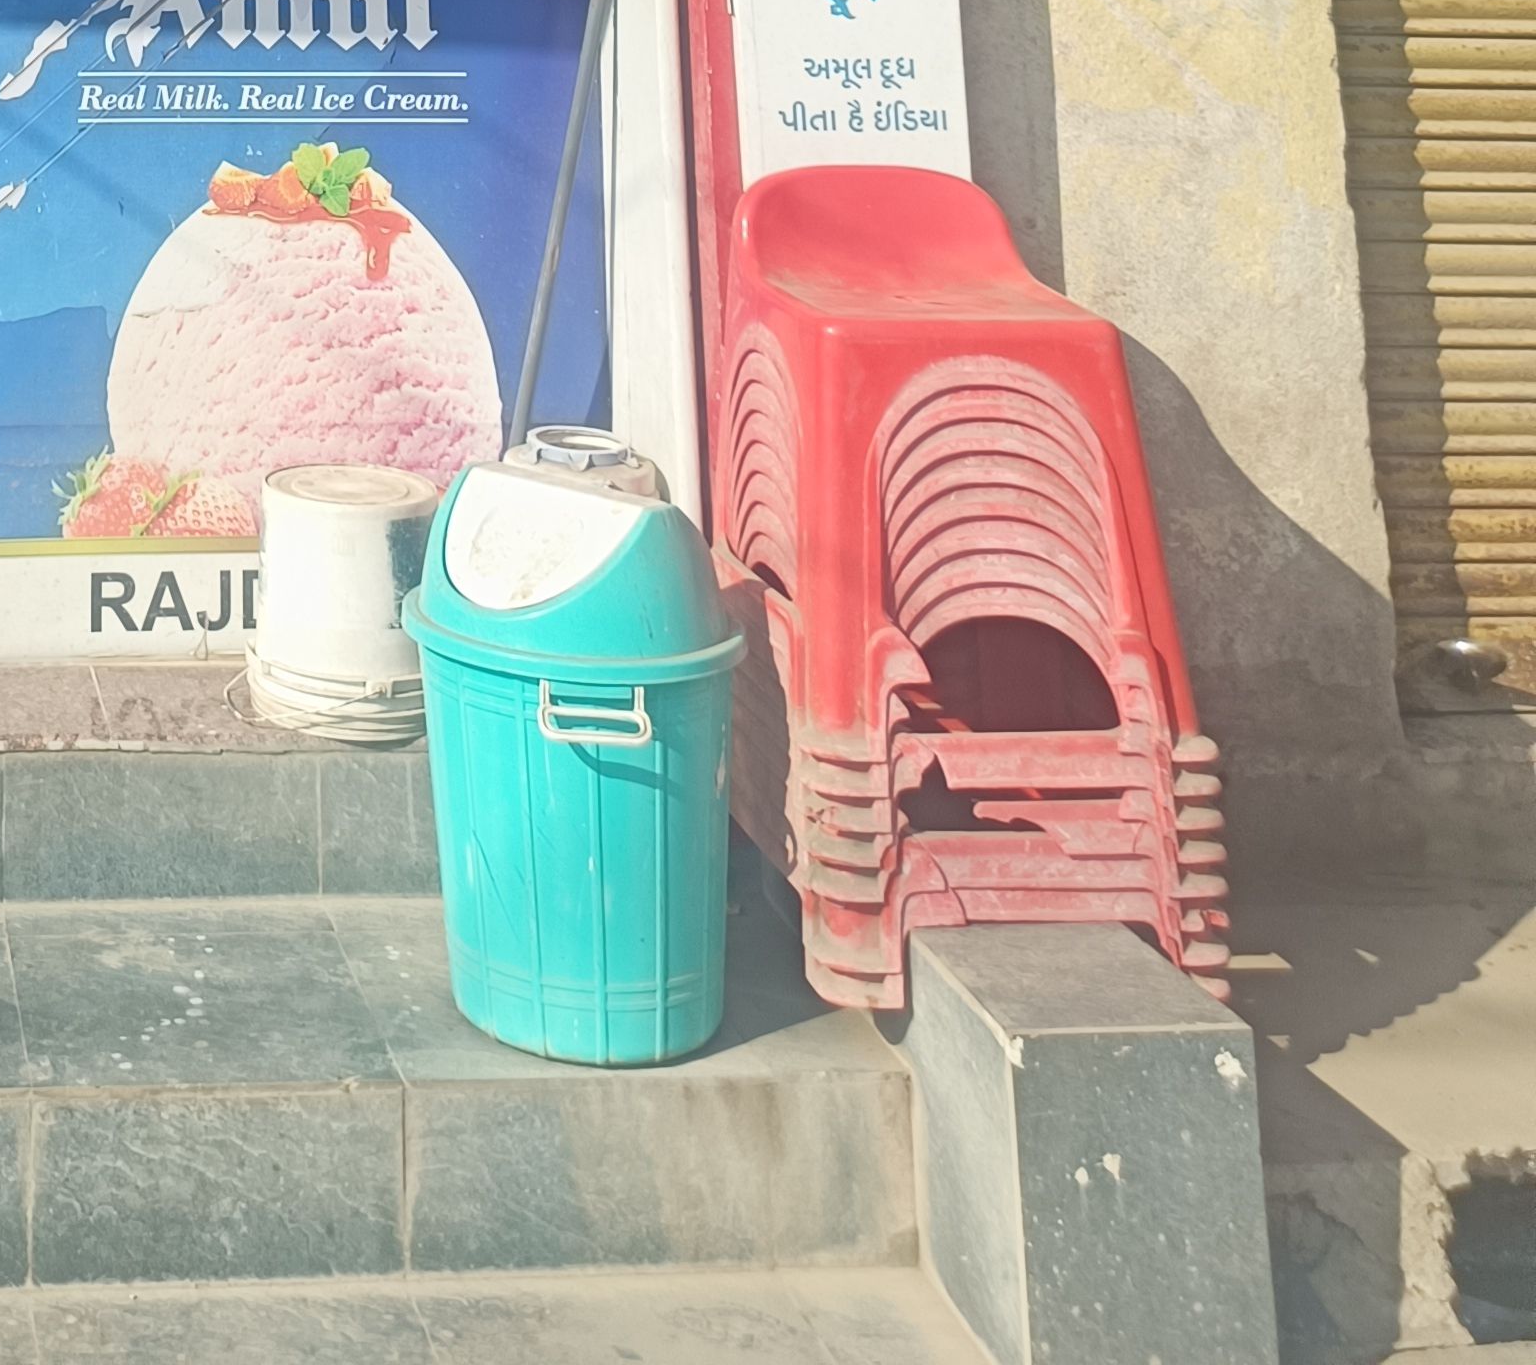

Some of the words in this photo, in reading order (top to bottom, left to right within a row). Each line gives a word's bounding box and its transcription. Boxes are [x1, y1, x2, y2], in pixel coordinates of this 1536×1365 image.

[803, 57, 872, 89] અમૂલ
[880, 56, 916, 89] દૂધ
[79, 83, 146, 111] Real
[155, 83, 230, 111] Milk.
[239, 83, 305, 111] Real
[311, 83, 356, 111] Ice
[362, 83, 469, 112] Cream.
[778, 100, 837, 131] પીતા
[846, 99, 864, 132] હૈ
